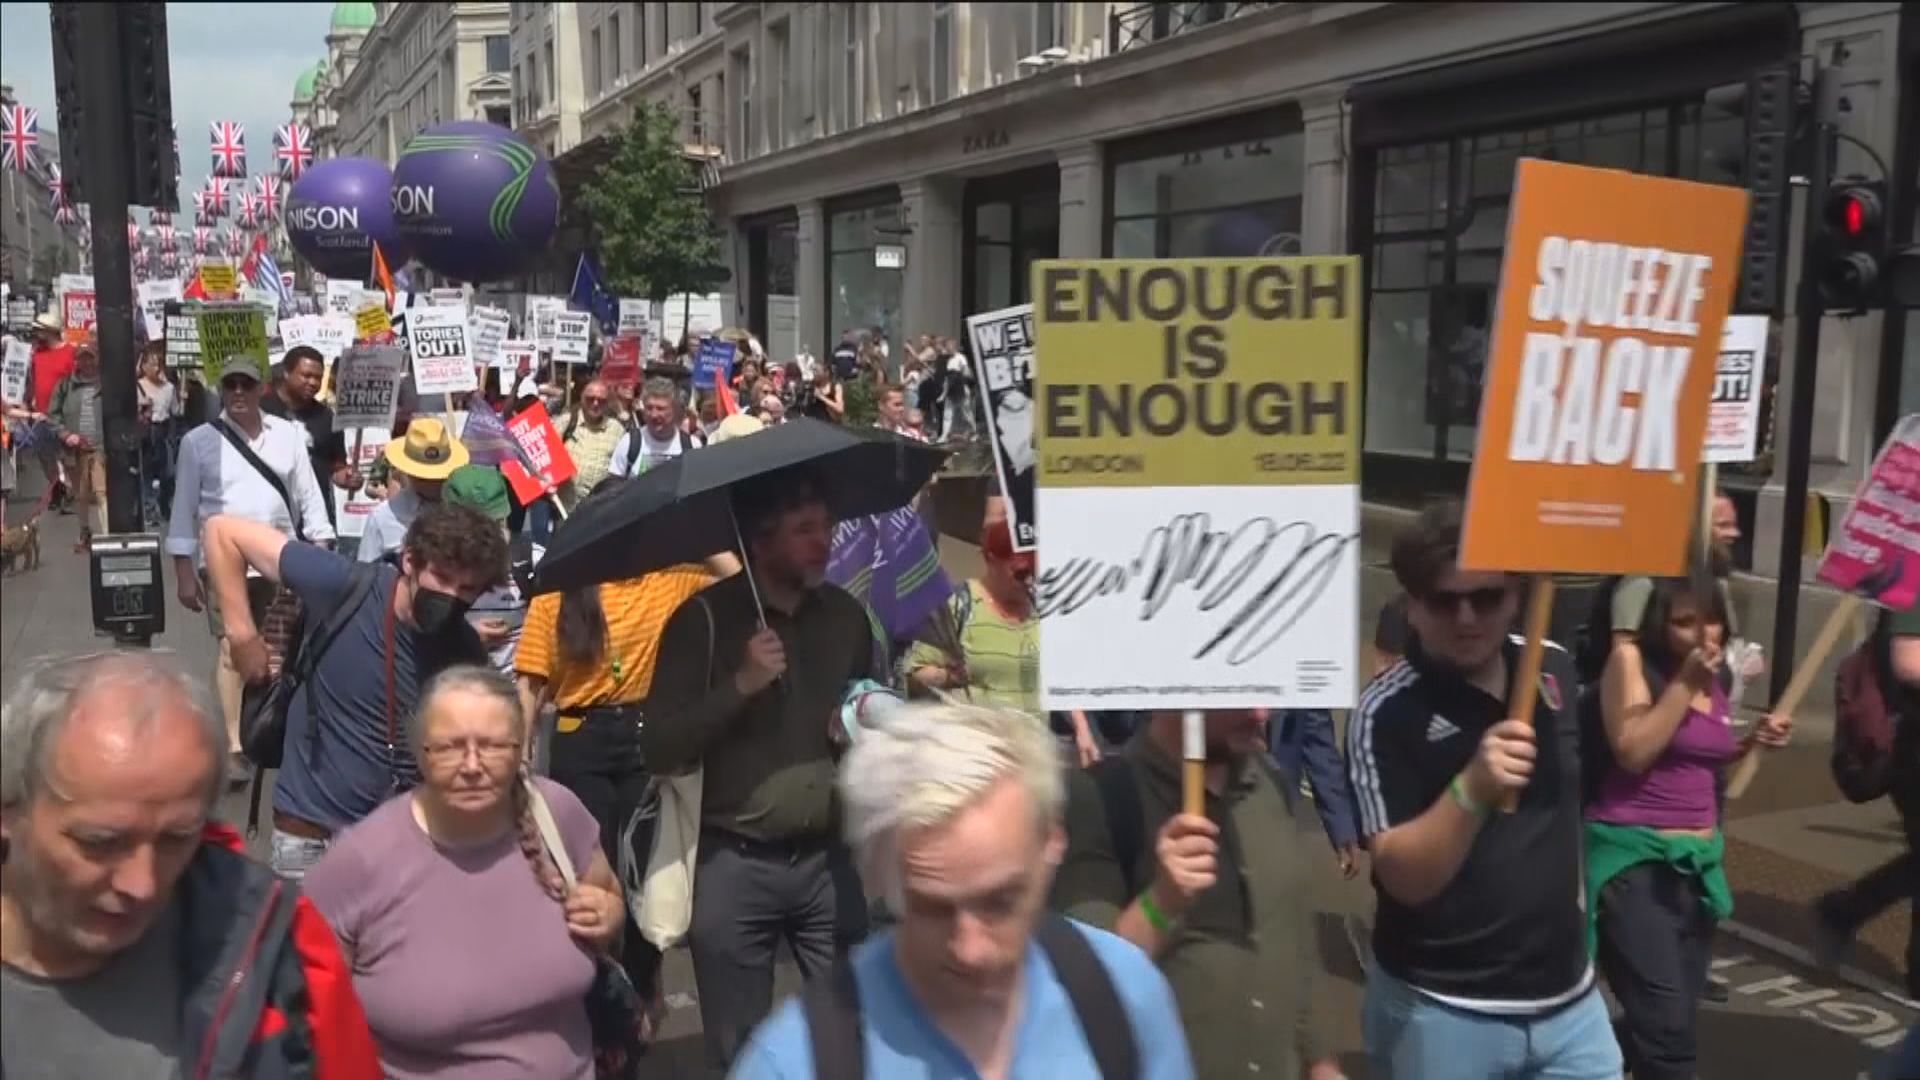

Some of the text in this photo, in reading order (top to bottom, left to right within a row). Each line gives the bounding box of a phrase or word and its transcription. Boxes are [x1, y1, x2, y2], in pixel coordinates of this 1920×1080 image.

[314, 234, 369, 248] Scotland
[1044, 264, 1348, 322] ENOUGH
[1529, 236, 1712, 341] SQUEEZE
[201, 311, 253, 327] SUPPORT
[561, 323, 584, 333] STOP
[414, 327, 462, 341] TORIES
[417, 340, 464, 357] OUT!
[1164, 324, 1228, 379] IS
[1711, 374, 1749, 400] UT!
[340, 389, 391, 406] STRIKE
[1045, 381, 1348, 438] ENOUGH
[1045, 454, 1145, 473] LONDON
